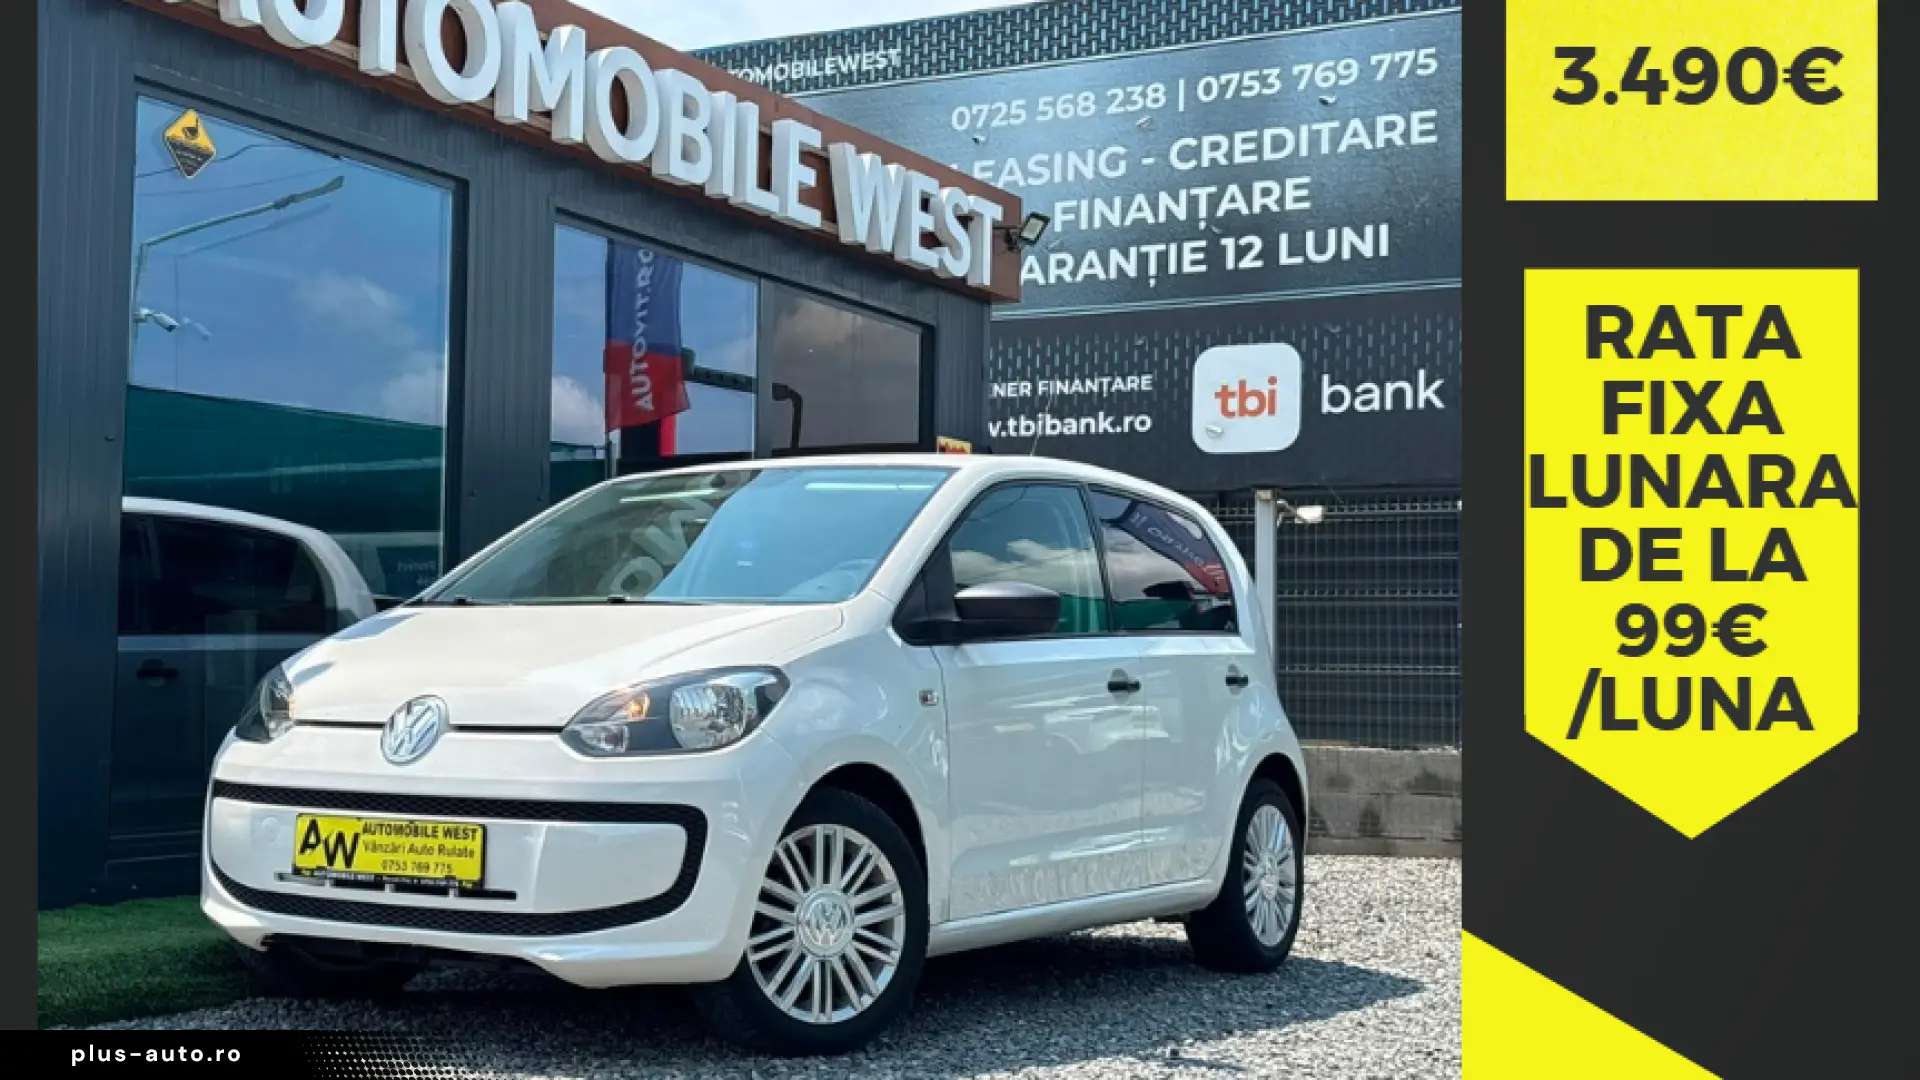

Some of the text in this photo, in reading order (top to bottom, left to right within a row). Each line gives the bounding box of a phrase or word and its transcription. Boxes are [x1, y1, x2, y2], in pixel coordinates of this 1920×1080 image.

[727, 48, 901, 83] OMOBILEWEST
[951, 99, 1027, 131] 0725
[1036, 91, 1096, 121] 568
[1106, 82, 1167, 115] 238
[1196, 67, 1281, 104] 0753
[1292, 58, 1359, 92] 769
[1370, 47, 1439, 82] 775
[163, 0, 1003, 287] UTOMOBILE WEST
[949, 146, 1127, 188] EASING
[1169, 108, 1439, 172] CREDITARE
[1053, 176, 1312, 231] FINANȚARE
[1020, 223, 1390, 288] ARANȚIE 12 LUNI
[1214, 368, 1446, 419] tbi bank
[299, 818, 361, 869] AW
[362, 821, 478, 842] AUTOMOBILE WEST
